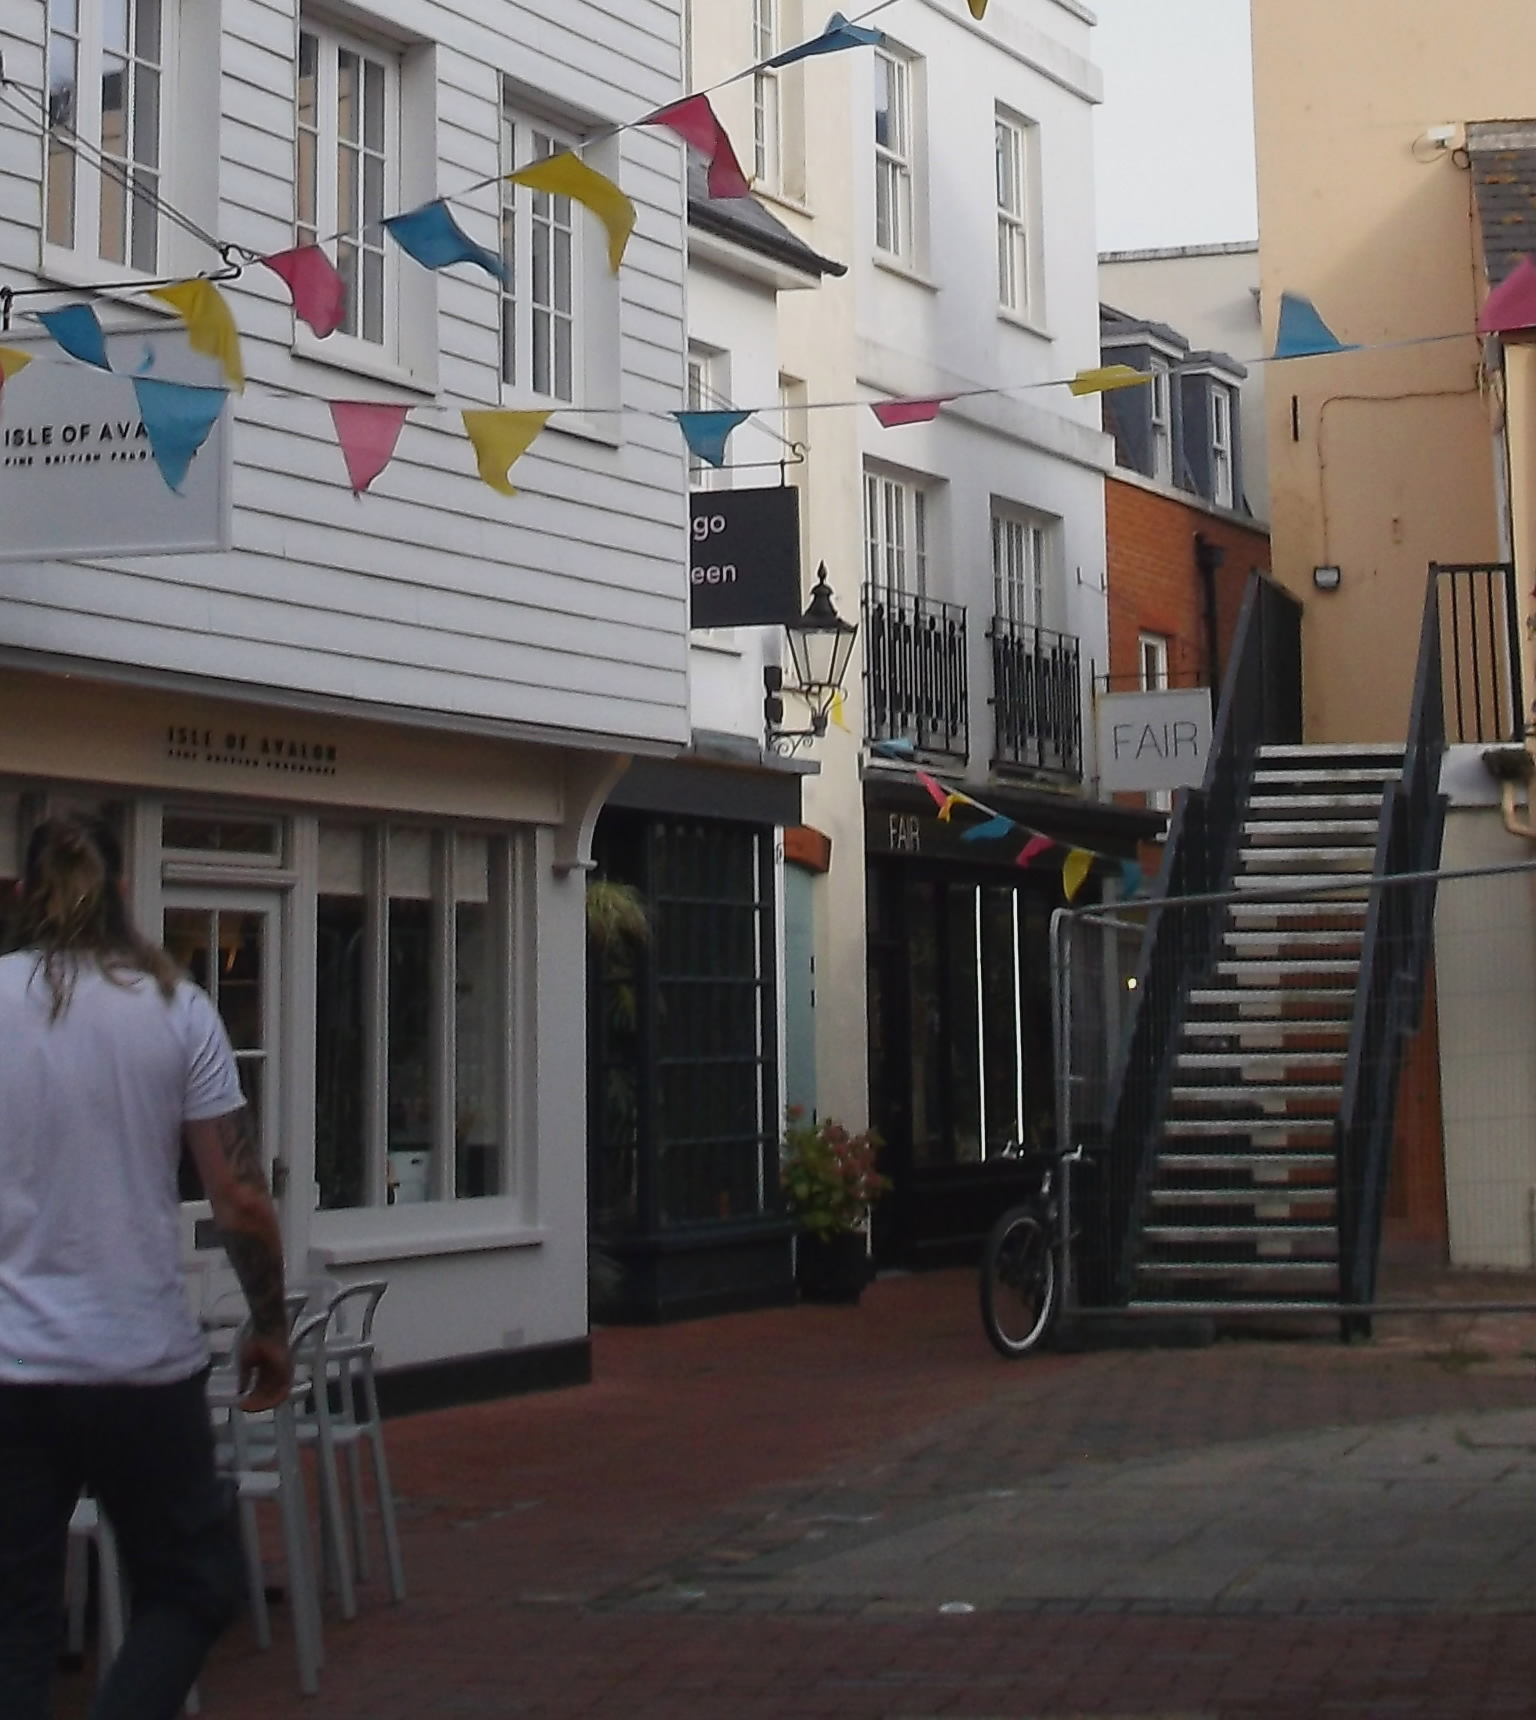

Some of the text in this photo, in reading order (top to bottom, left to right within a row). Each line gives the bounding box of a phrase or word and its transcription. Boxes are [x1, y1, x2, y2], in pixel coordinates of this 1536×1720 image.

[5, 426, 53, 447] ISLE
[62, 424, 91, 443] OF
[1114, 721, 1199, 759] FAIR
[889, 813, 920, 852] FAIR
